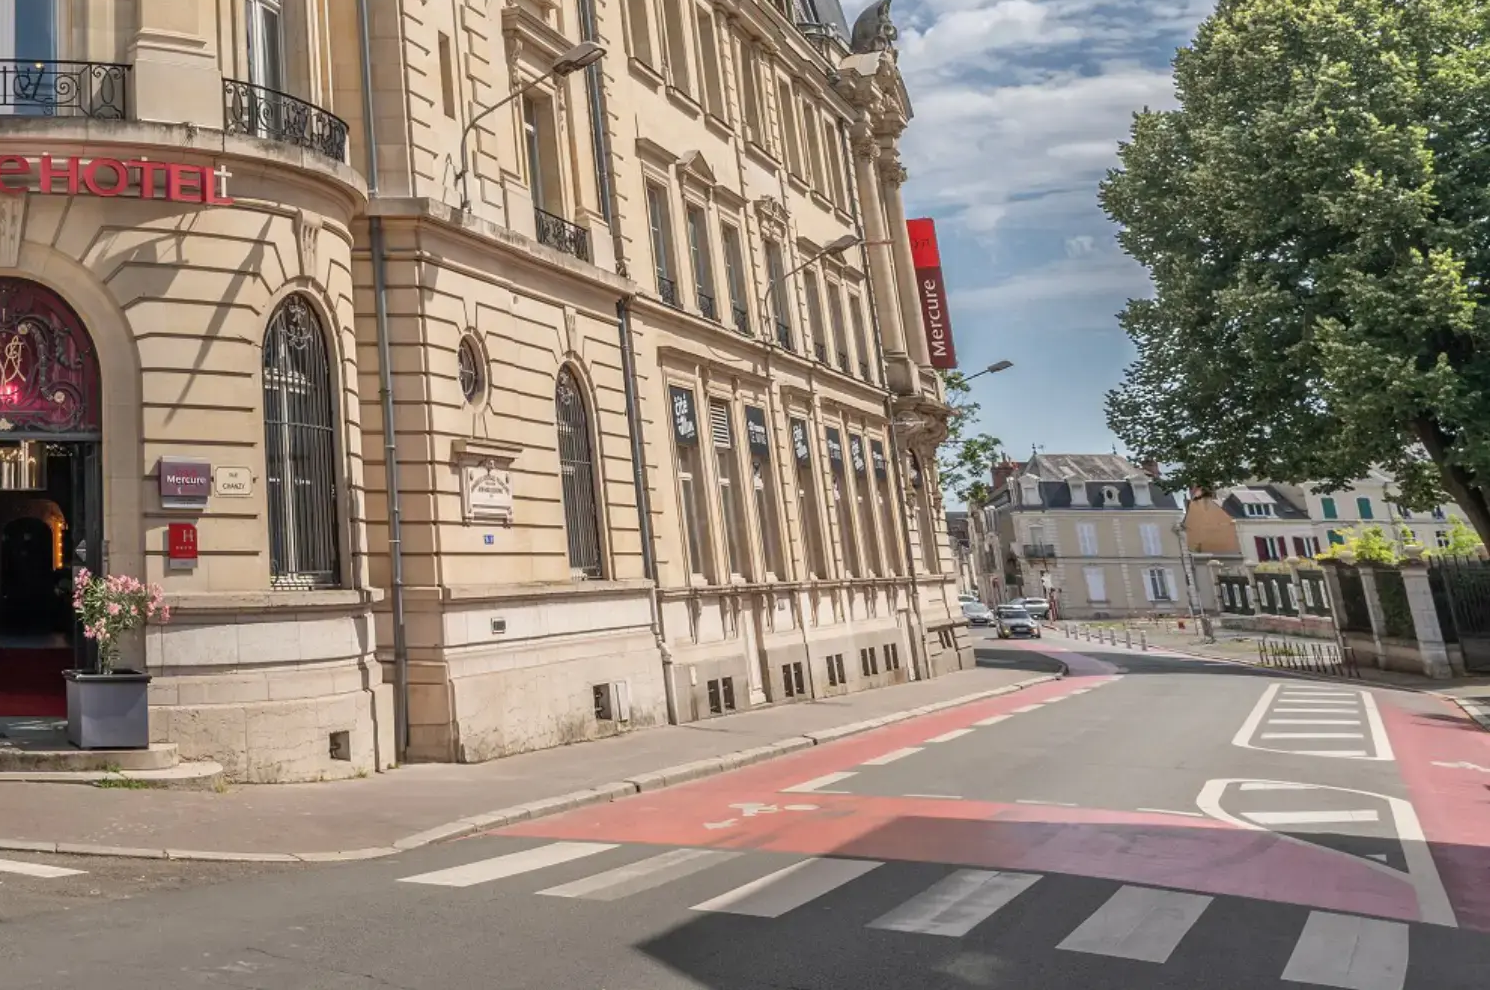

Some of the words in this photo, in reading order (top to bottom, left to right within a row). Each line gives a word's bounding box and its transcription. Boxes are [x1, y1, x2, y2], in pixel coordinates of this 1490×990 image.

[39, 155, 234, 205] HOTEL
[924, 279, 947, 356] Mercure
[166, 475, 206, 484] Mercure
